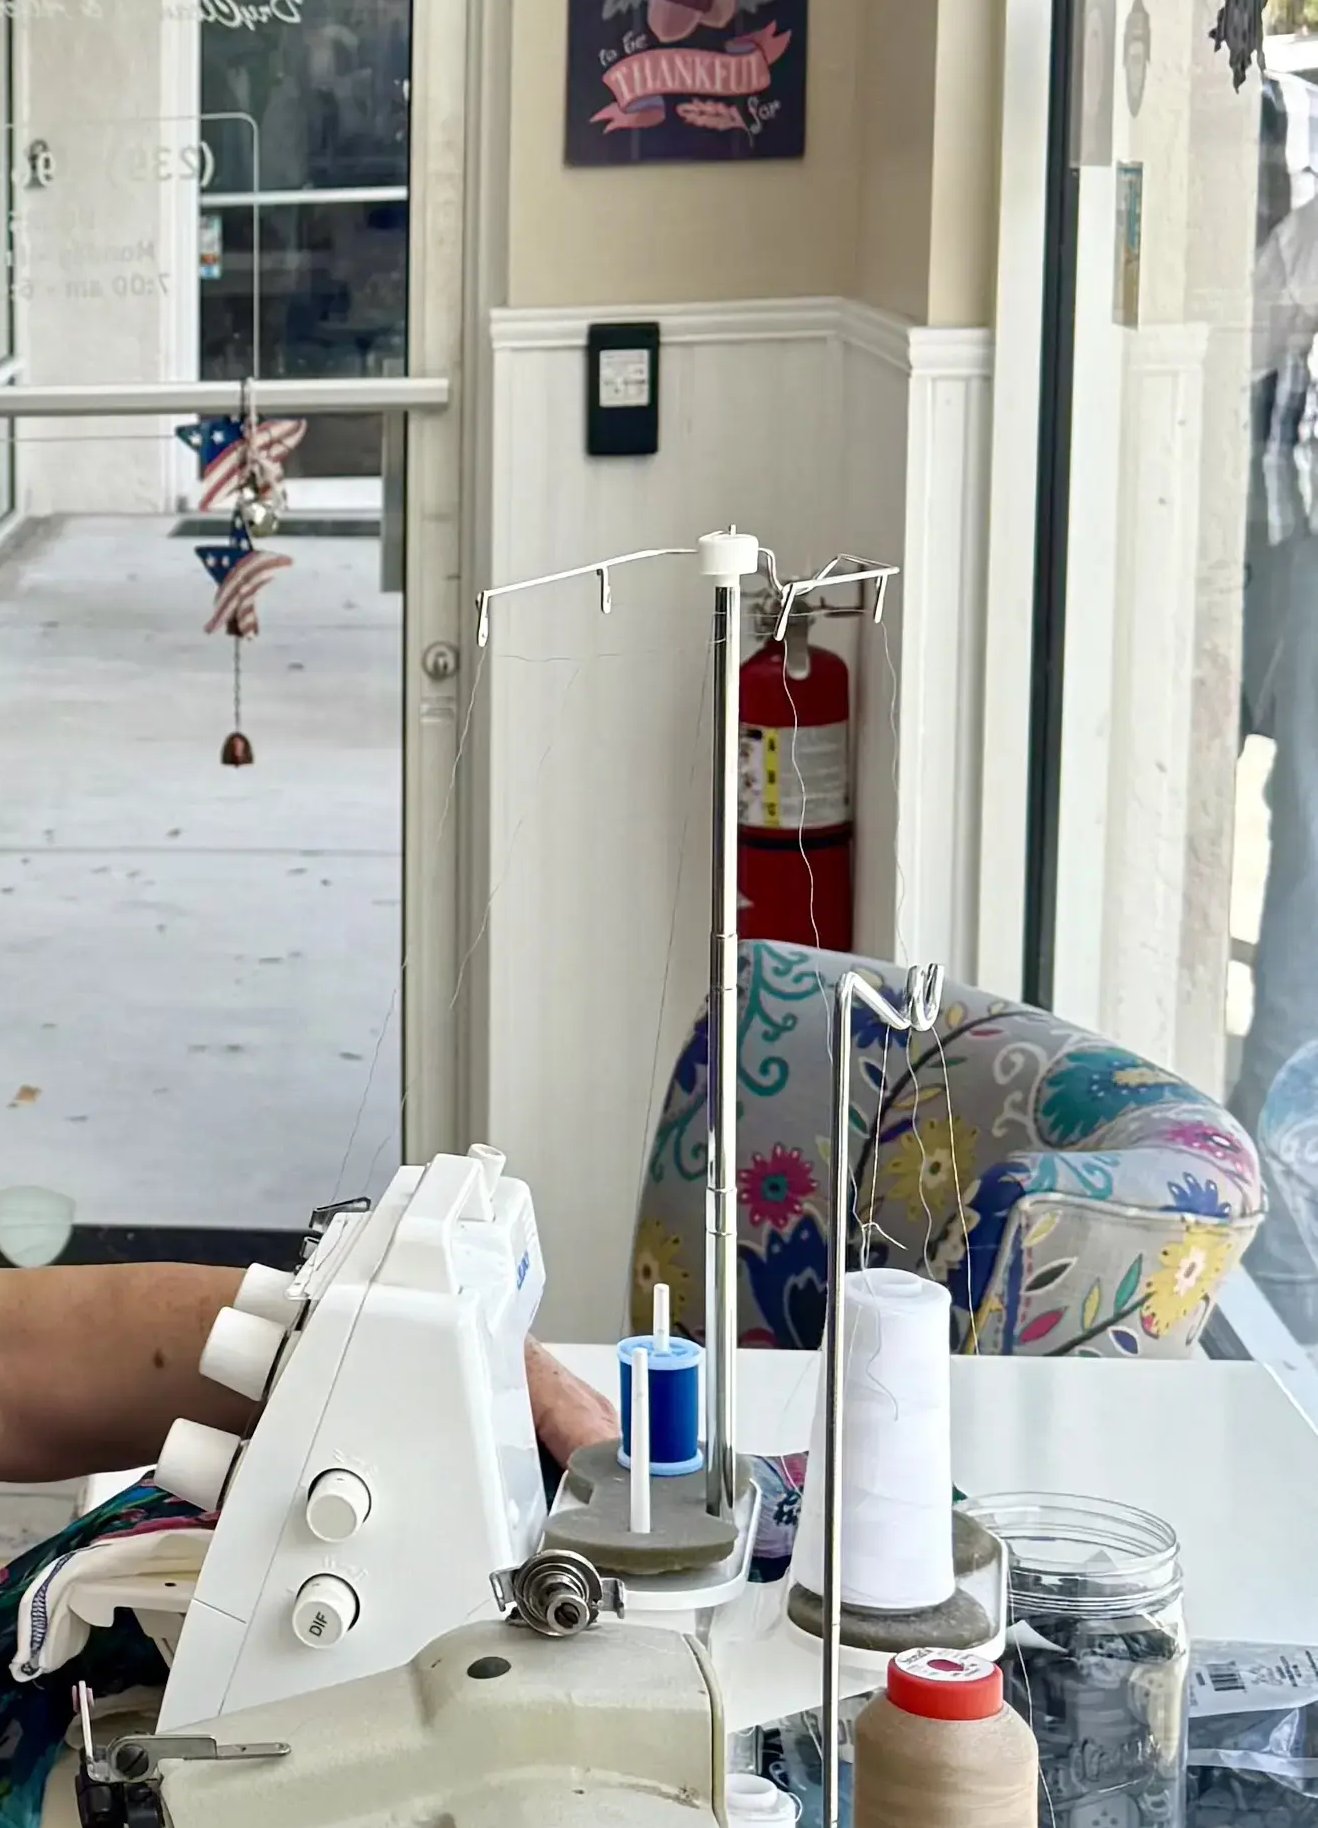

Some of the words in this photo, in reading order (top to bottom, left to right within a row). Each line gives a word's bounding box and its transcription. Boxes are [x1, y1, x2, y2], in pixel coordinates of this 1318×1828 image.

[613, 55, 764, 100] THANKFUL
[746, 96, 782, 135] for
[309, 1611, 329, 1637] DIF
